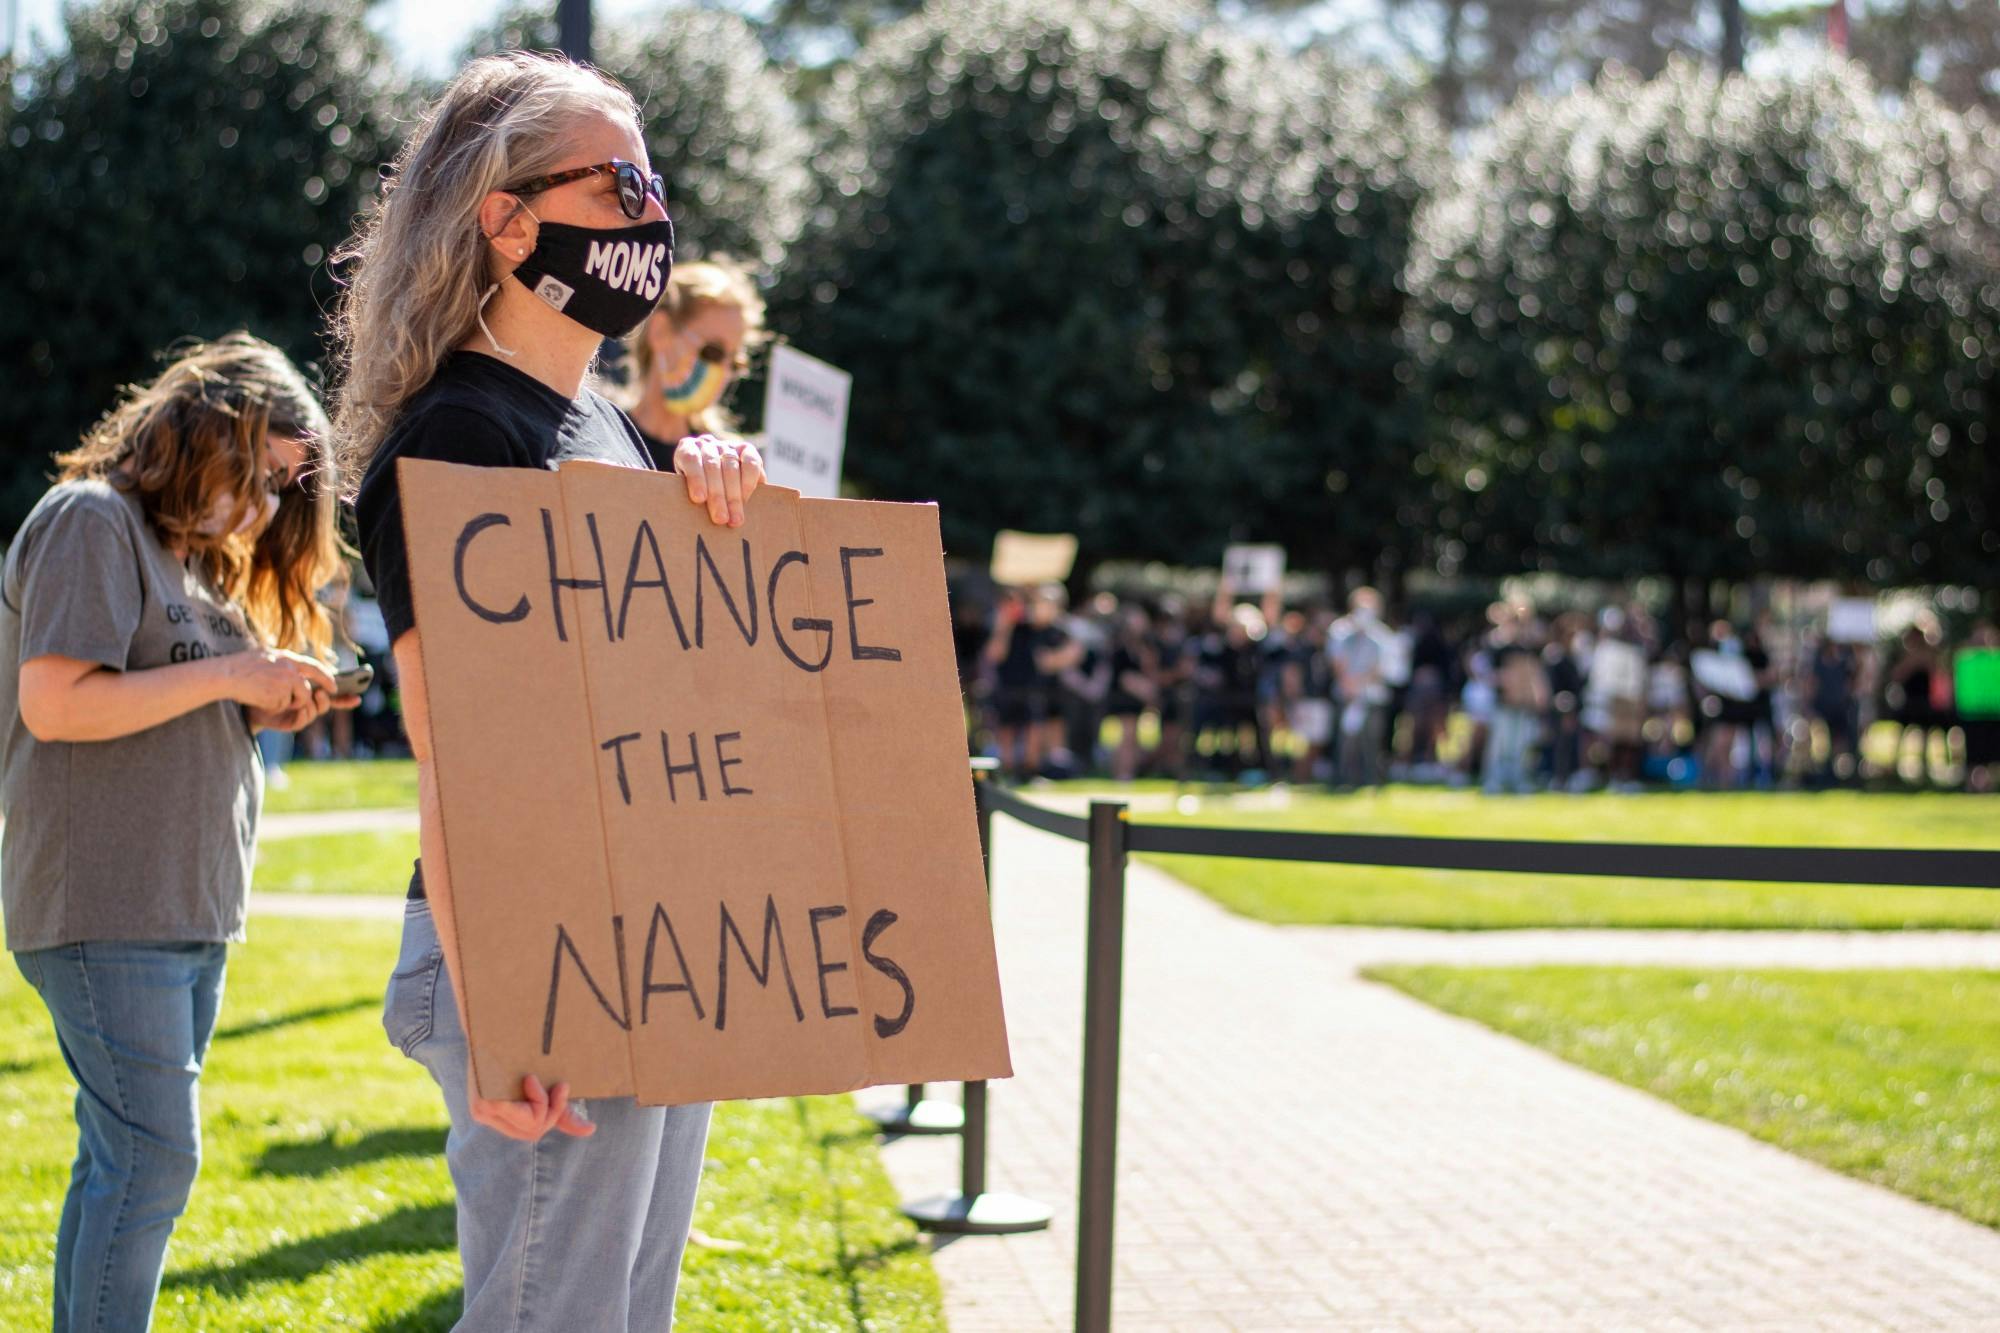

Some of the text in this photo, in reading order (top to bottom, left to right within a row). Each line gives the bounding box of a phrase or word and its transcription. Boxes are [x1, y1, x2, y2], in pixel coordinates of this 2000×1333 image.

[585, 240, 665, 301] MOMS
[453, 508, 902, 672] CHANGE
[601, 730, 753, 804] THE
[543, 894, 915, 1055] NAMES
